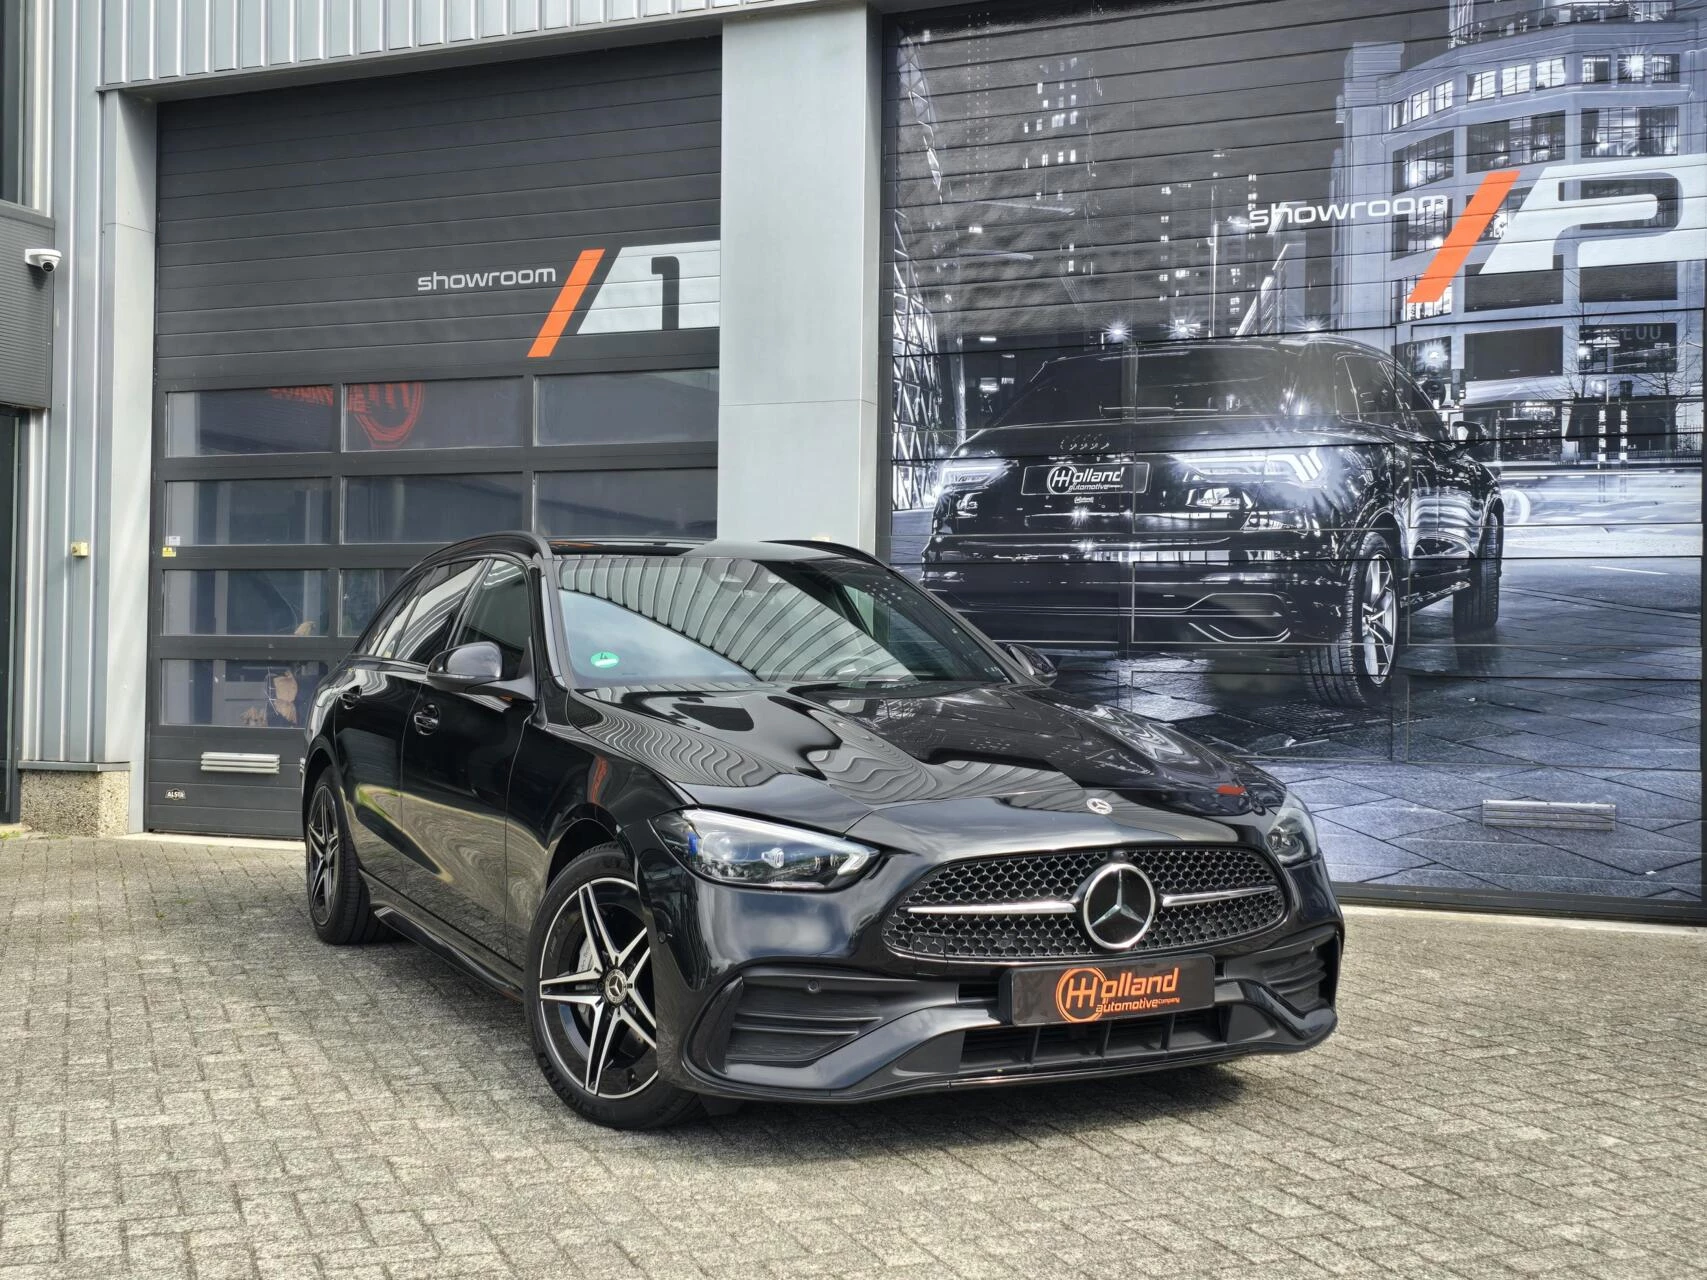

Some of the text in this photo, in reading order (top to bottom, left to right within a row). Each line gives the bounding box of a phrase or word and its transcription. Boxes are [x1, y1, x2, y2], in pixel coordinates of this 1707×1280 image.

[1249, 171, 1684, 270] showroom 2
[417, 256, 680, 329] showroom 1
[1050, 466, 1125, 488] Holland
[1062, 967, 1179, 1010] Holland
[1096, 997, 1158, 1013] automotive
